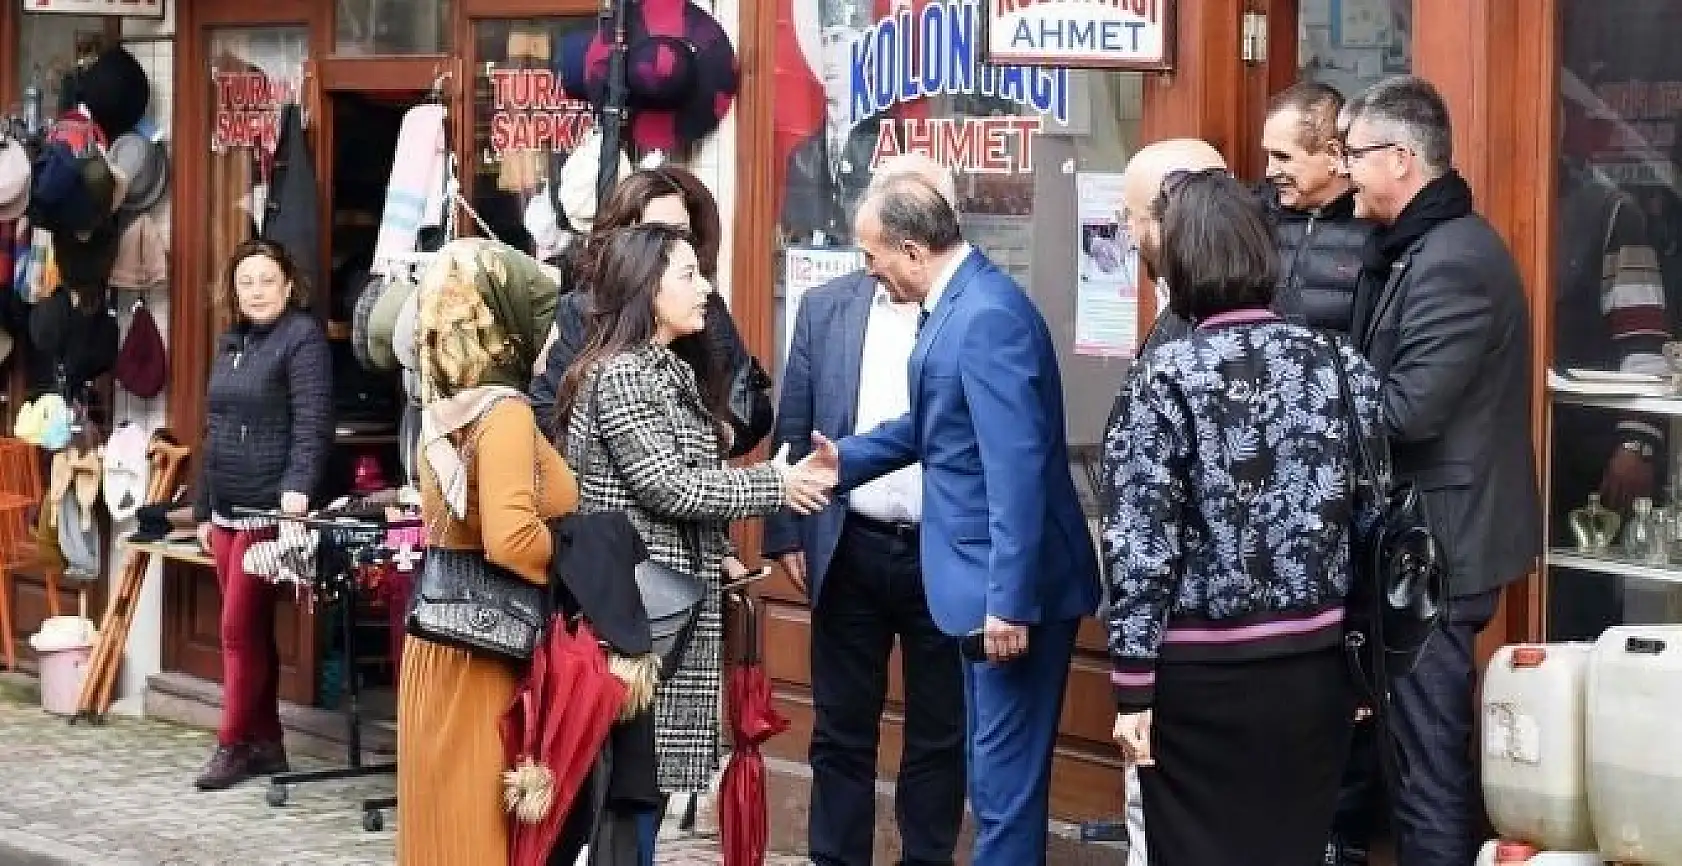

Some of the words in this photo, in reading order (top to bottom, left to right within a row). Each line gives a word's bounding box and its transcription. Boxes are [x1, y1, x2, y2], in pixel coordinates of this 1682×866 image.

[1010, 17, 1147, 52] AHMET
[490, 68, 595, 110] TURA
[867, 116, 1042, 174] AHMET
